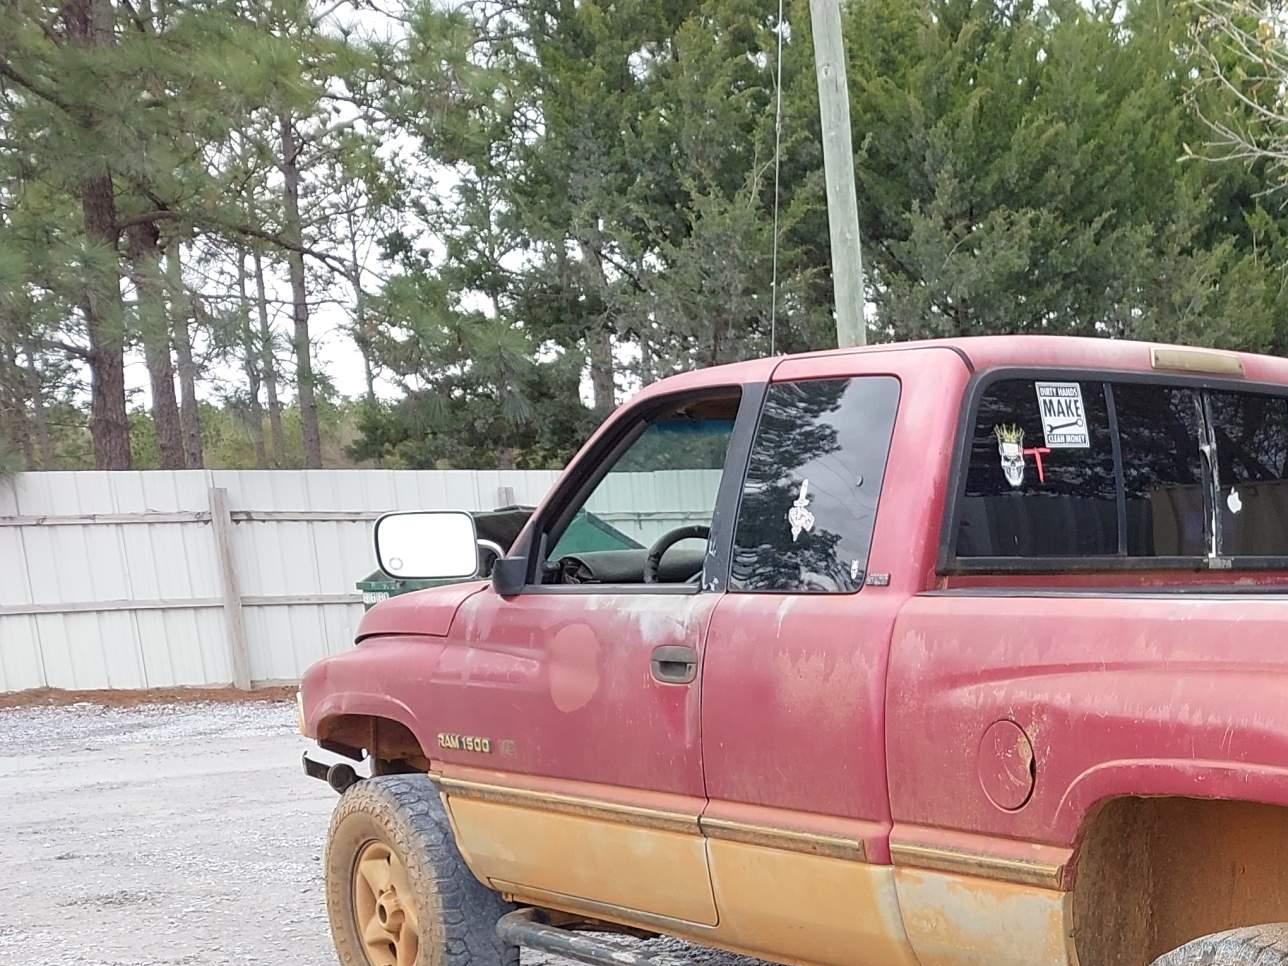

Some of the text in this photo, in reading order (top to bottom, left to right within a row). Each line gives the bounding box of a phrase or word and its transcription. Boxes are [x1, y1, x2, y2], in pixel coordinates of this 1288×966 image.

[1042, 398, 1082, 418] MAKE
[437, 732, 459, 750] RAM
[460, 735, 491, 753] 1500
